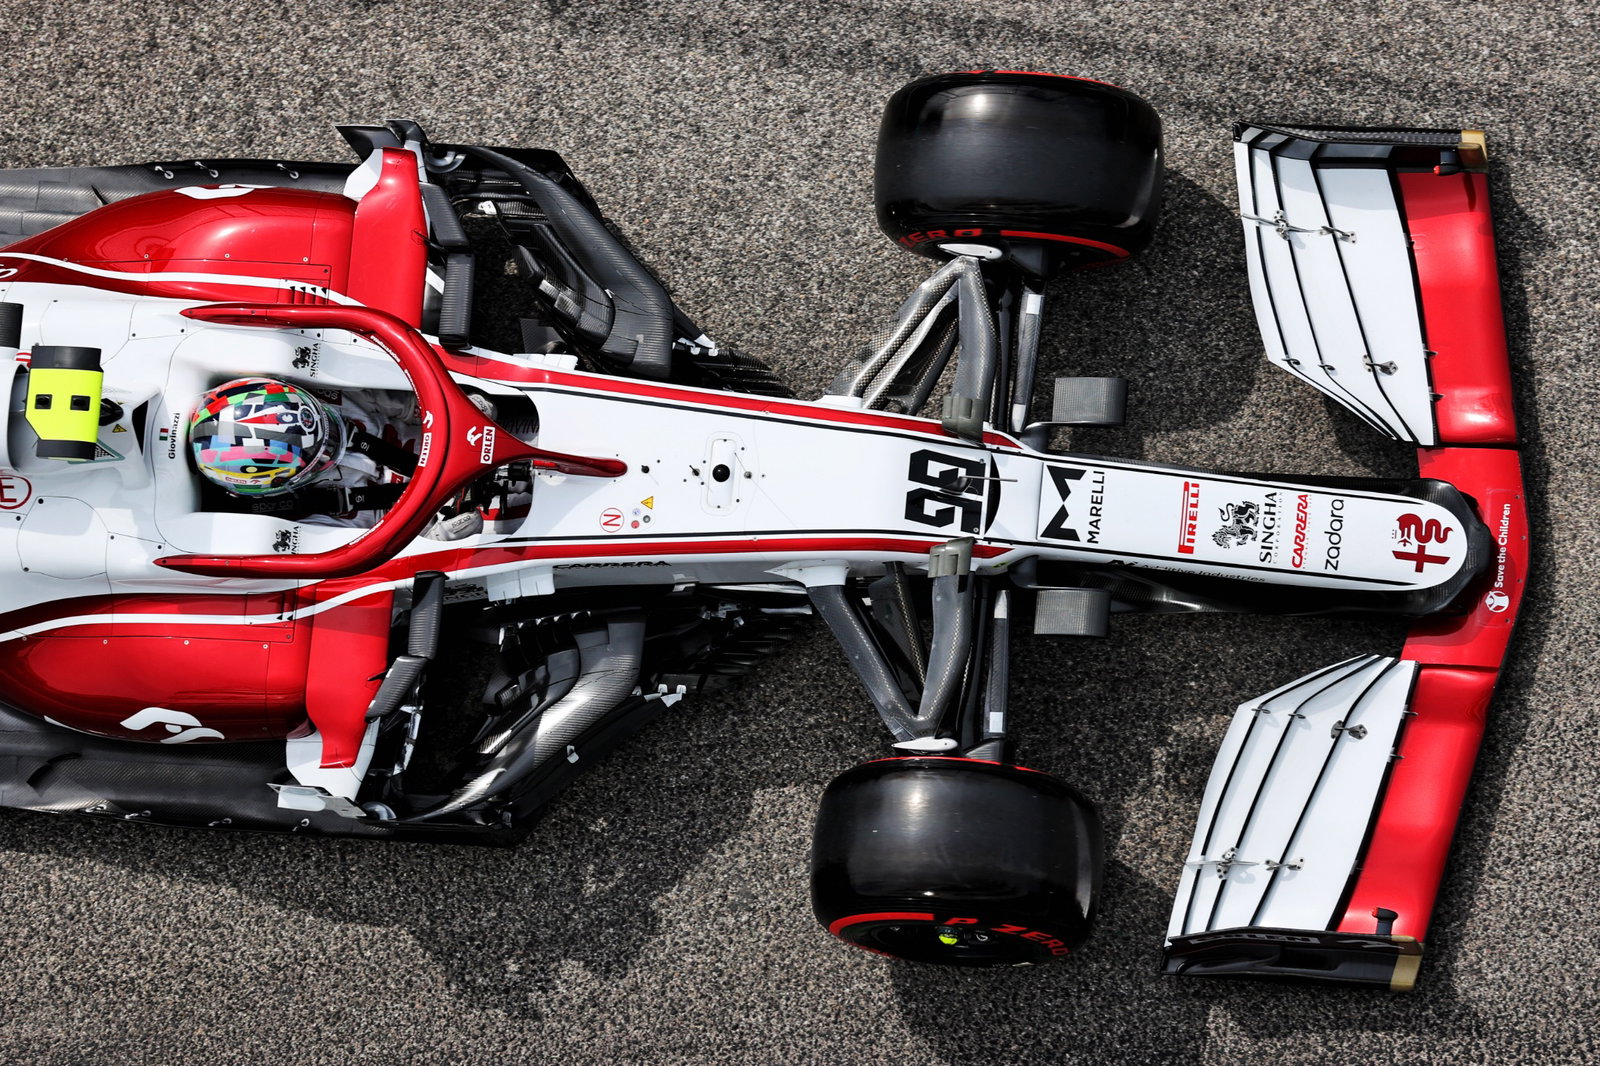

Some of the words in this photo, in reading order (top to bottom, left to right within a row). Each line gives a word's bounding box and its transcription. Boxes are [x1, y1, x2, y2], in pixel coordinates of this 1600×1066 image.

[309, 342, 319, 378] SINGHA
[168, 412, 180, 460] Giovinazzi
[420, 434, 430, 465] ORLEN
[483, 428, 493, 462] ORLEN
[904, 449, 986, 535] 99
[1087, 470, 1105, 544] MARELLI
[1178, 481, 1200, 555] PIRELLI
[1259, 491, 1278, 564] SINGHA
[1291, 493, 1309, 569] CARRERA
[1324, 499, 1345, 571] zadara
[1498, 503, 1511, 546] Children
[291, 525, 300, 555] INGHA
[1496, 547, 1507, 563] the
[552, 560, 672, 570] CARRERA
[1198, 570, 1266, 582] Industries
[1494, 565, 1505, 588] Save
[943, 917, 979, 925] P
[989, 923, 1070, 957] ZERO
